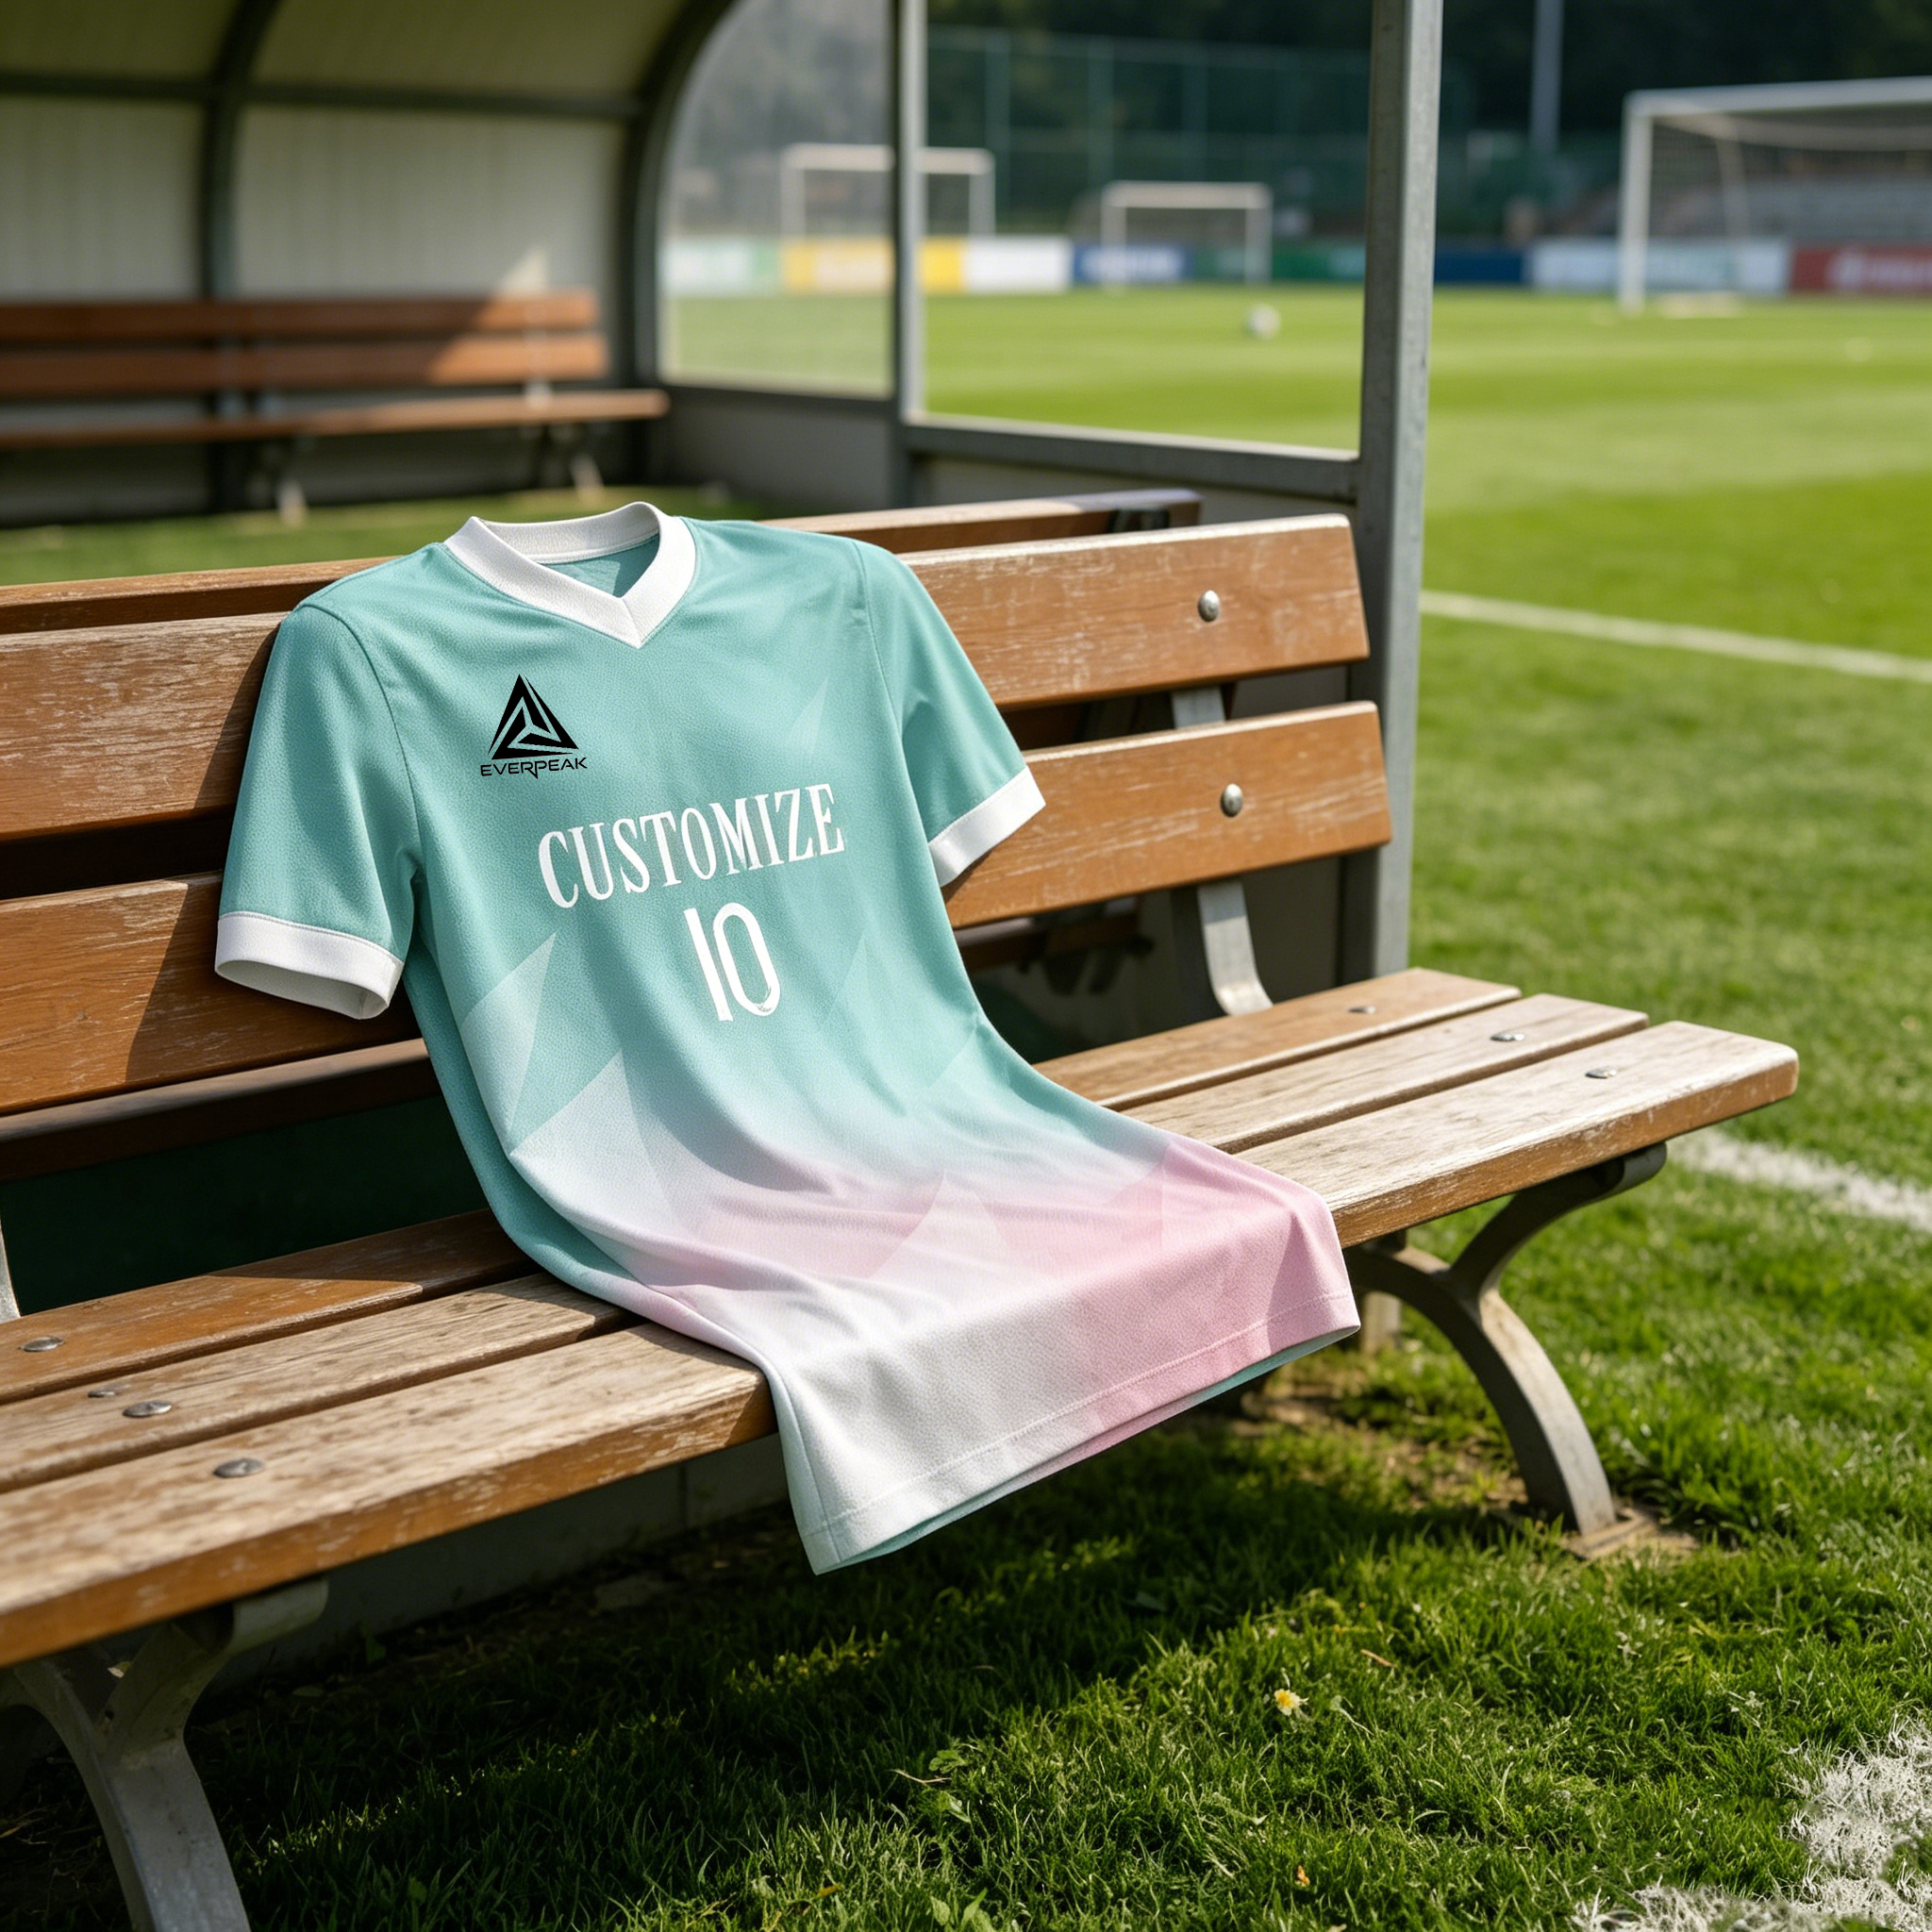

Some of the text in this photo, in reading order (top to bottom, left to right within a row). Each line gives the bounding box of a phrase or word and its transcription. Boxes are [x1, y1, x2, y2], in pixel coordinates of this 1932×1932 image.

[480, 758, 588, 779] EVERPEAK
[539, 784, 844, 908] CUSTOMIZE
[684, 902, 780, 1022] 10
